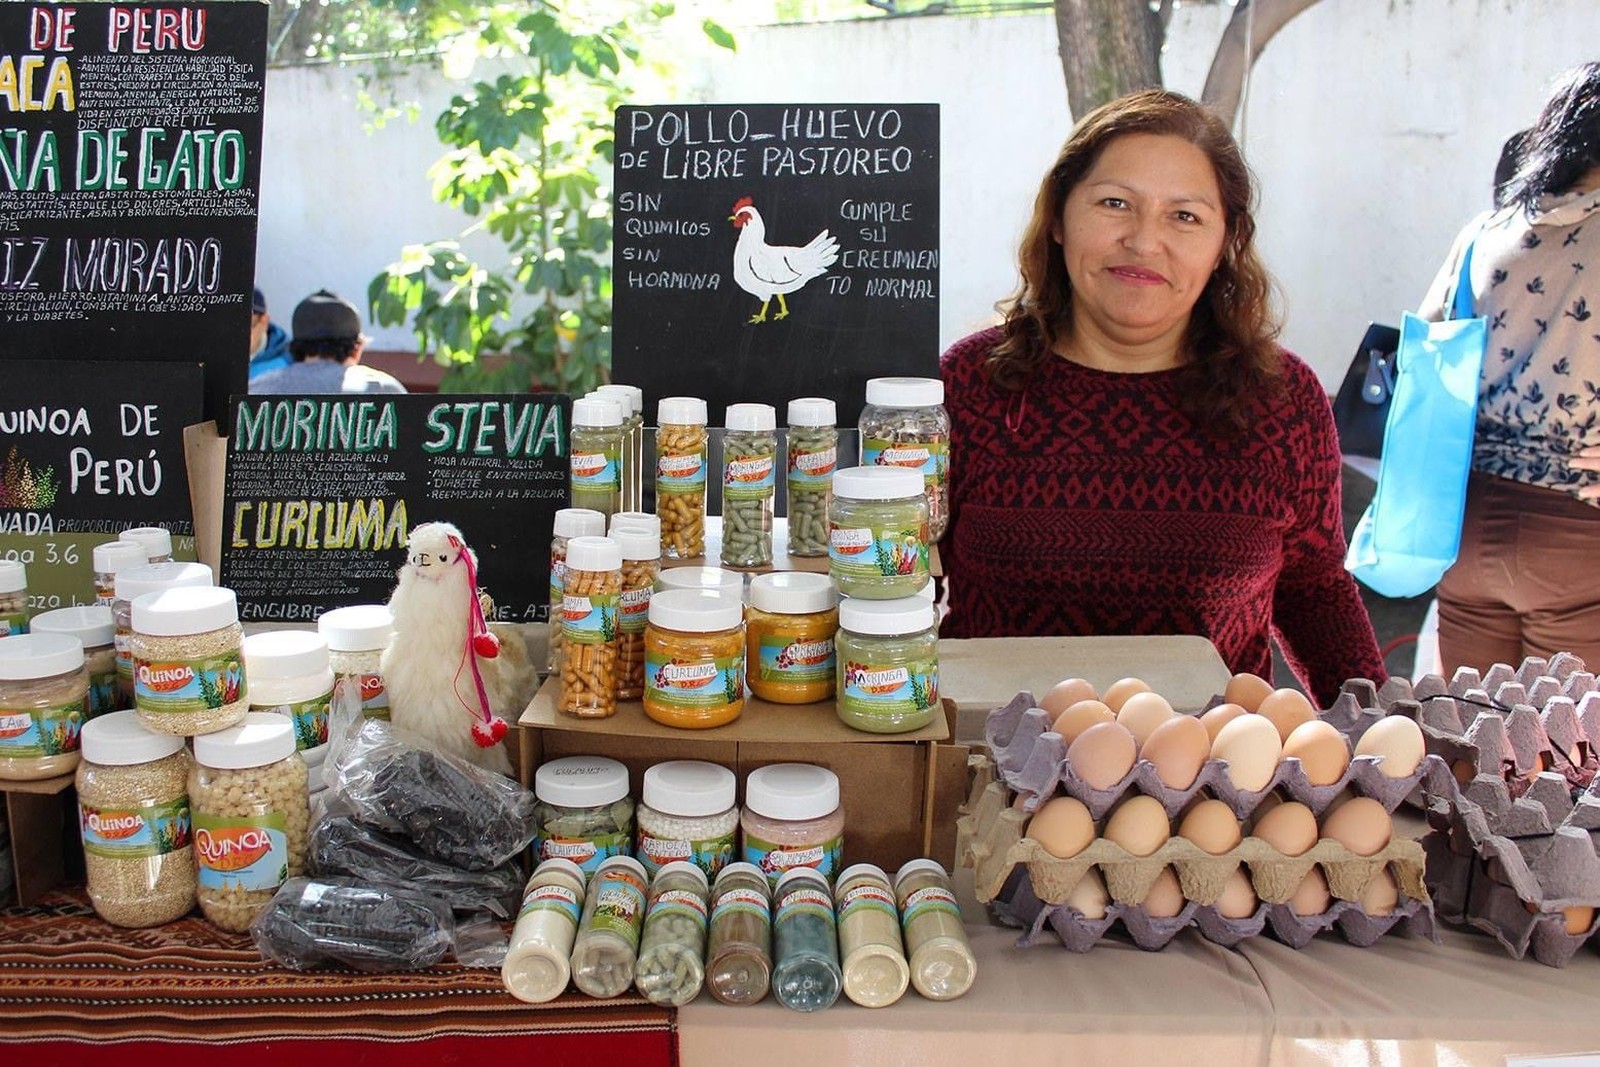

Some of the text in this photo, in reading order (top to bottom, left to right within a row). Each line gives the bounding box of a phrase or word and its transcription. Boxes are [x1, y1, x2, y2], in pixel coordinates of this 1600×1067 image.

[30, 7, 207, 53] DE PERU
[122, 64, 131, 73] LA
[229, 63, 254, 73] FISICA
[131, 55, 145, 65] DEL
[148, 55, 187, 64] SISTEMA
[189, 55, 236, 65] HORMONAL
[151, 82, 160, 91] LA
[176, 73, 190, 82] LOS
[193, 73, 226, 82] EFECTOS
[229, 73, 246, 82] DEL
[175, 99, 185, 108] LE
[189, 99, 200, 107] DA
[203, 97, 241, 107] CALIDAD
[245, 96, 257, 106] DE
[77, 115, 151, 129] DISFUNCION
[76, 128, 128, 191] DE
[138, 128, 245, 191] GATO
[619, 145, 913, 180] DE LIBRE PASTOREO
[69, 200, 107, 210] REDUCE
[111, 200, 130, 209] LOS
[618, 191, 662, 213] SIN
[840, 199, 913, 223] CUMPLE
[859, 226, 887, 244] SU
[63, 237, 222, 293] MORADO
[622, 247, 660, 263] SIN
[842, 249, 938, 270] CRECIMIEN
[628, 270, 721, 291] HORMONA
[826, 275, 937, 299] TO NORMAL
[75, 301, 129, 311] COMBATE
[135, 302, 148, 311] LA
[167, 294, 244, 304] ANTIOXIDANTE
[16, 313, 29, 321] LA
[120, 402, 160, 437] DE
[234, 399, 567, 458] MORINGA STEVIA
[232, 499, 409, 550] CURCUMA
[238, 602, 326, 622] ENGIBRE
[196, 828, 273, 862] QUINOA
